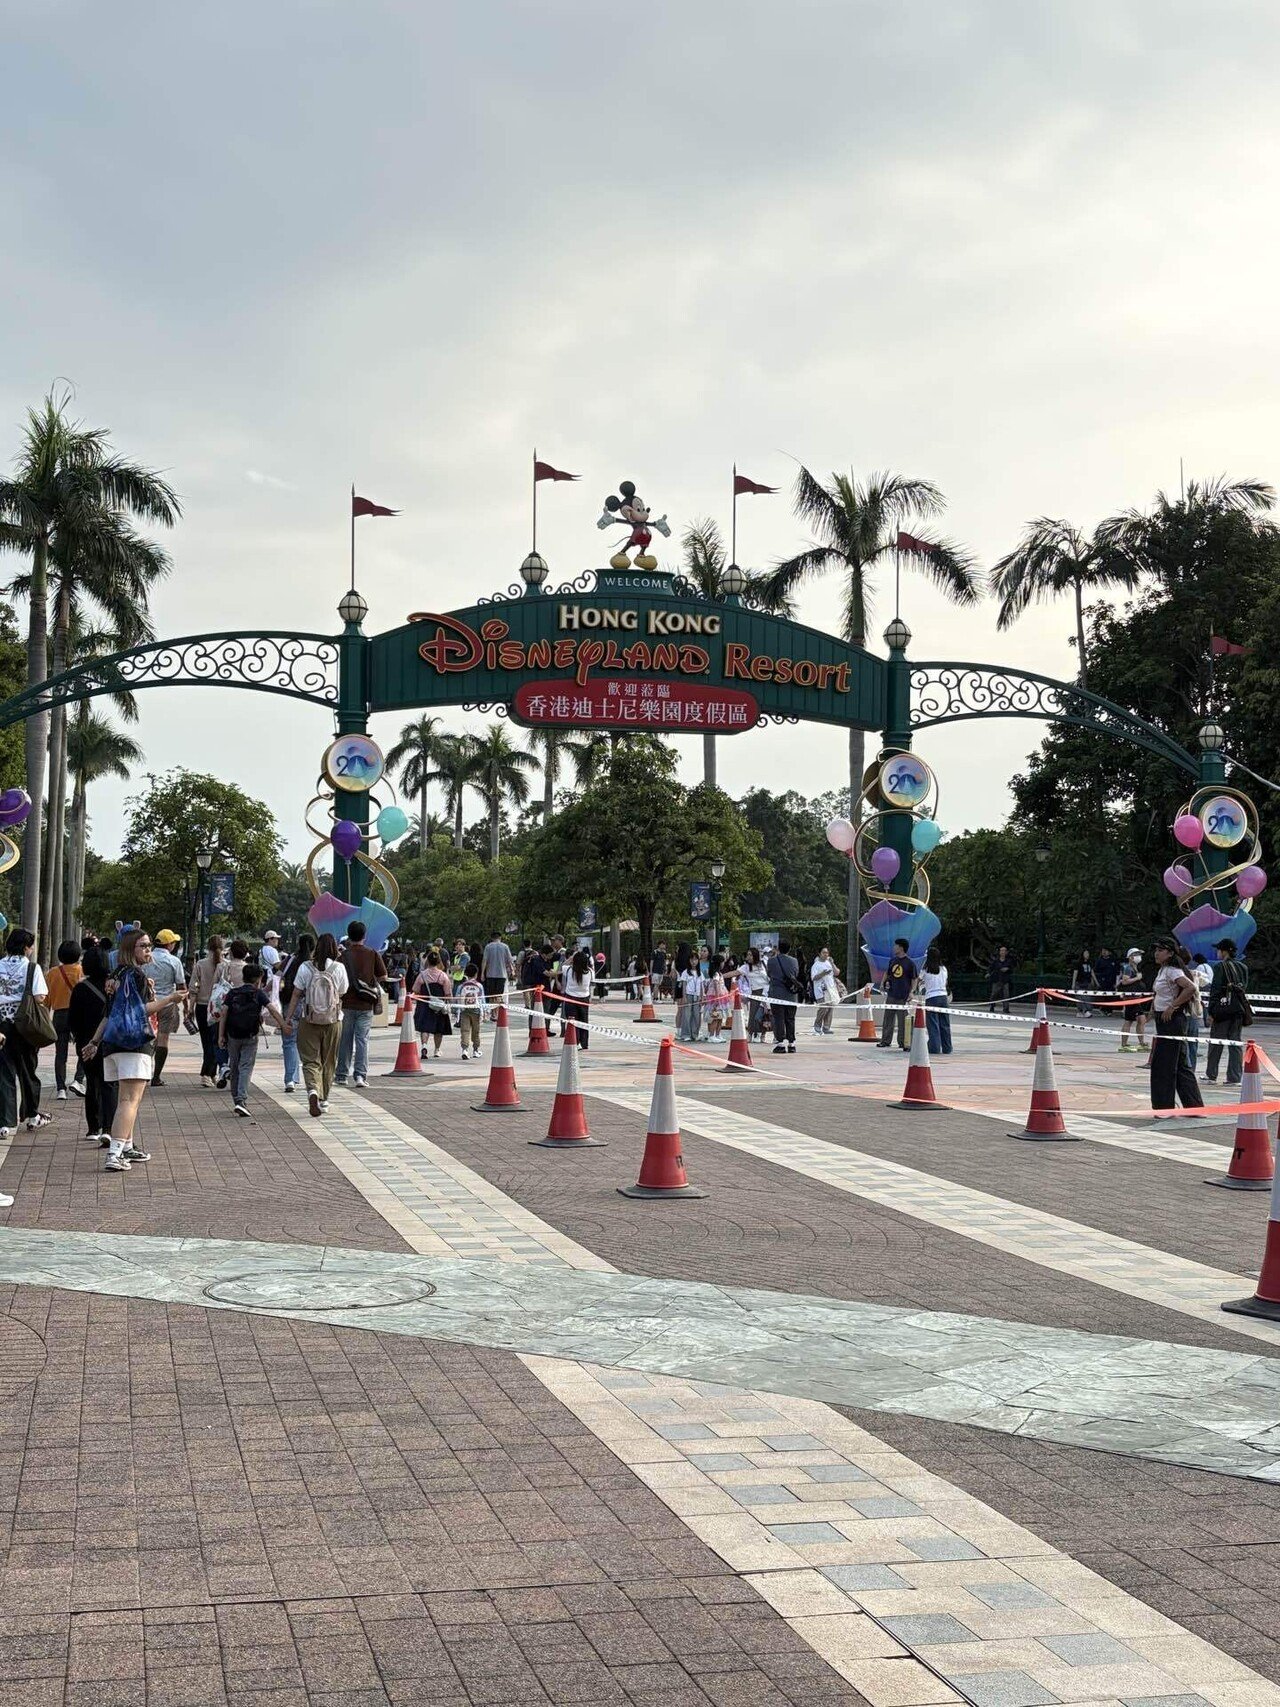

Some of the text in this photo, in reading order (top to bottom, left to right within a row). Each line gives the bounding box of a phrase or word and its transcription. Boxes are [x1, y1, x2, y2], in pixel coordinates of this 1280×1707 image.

[604, 576, 669, 590] WELCOME
[558, 604, 722, 635] HONG KONG
[724, 642, 852, 694] Resort
[526, 694, 748, 725] 香港迪士尼樂園度假區
